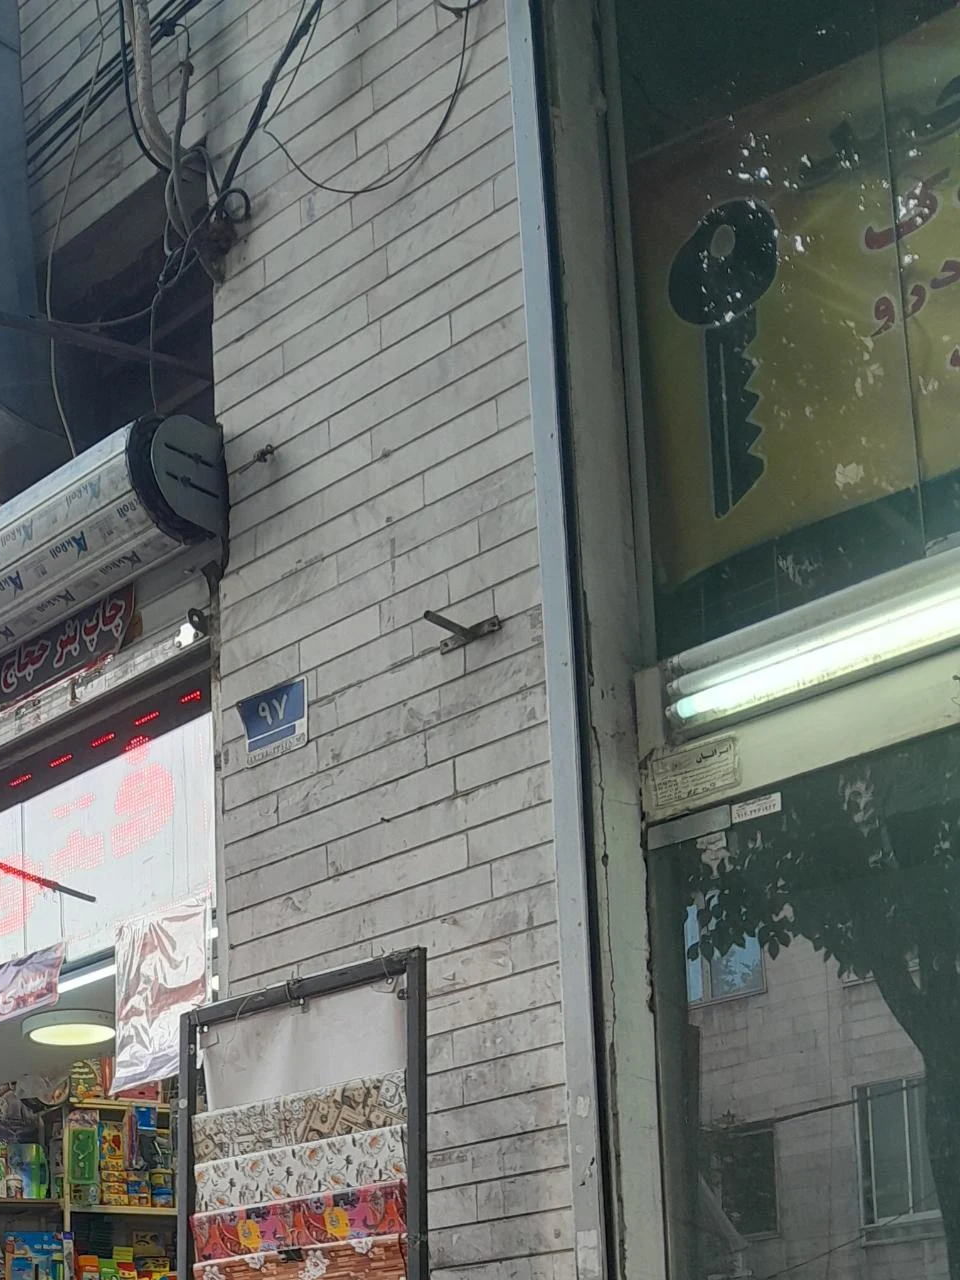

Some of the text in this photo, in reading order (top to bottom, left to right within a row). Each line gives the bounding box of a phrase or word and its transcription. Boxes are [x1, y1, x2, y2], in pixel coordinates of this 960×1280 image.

[117, 498, 140, 519] Roll
[53, 618, 80, 668] بنر
[82, 595, 126, 652] چاپ
